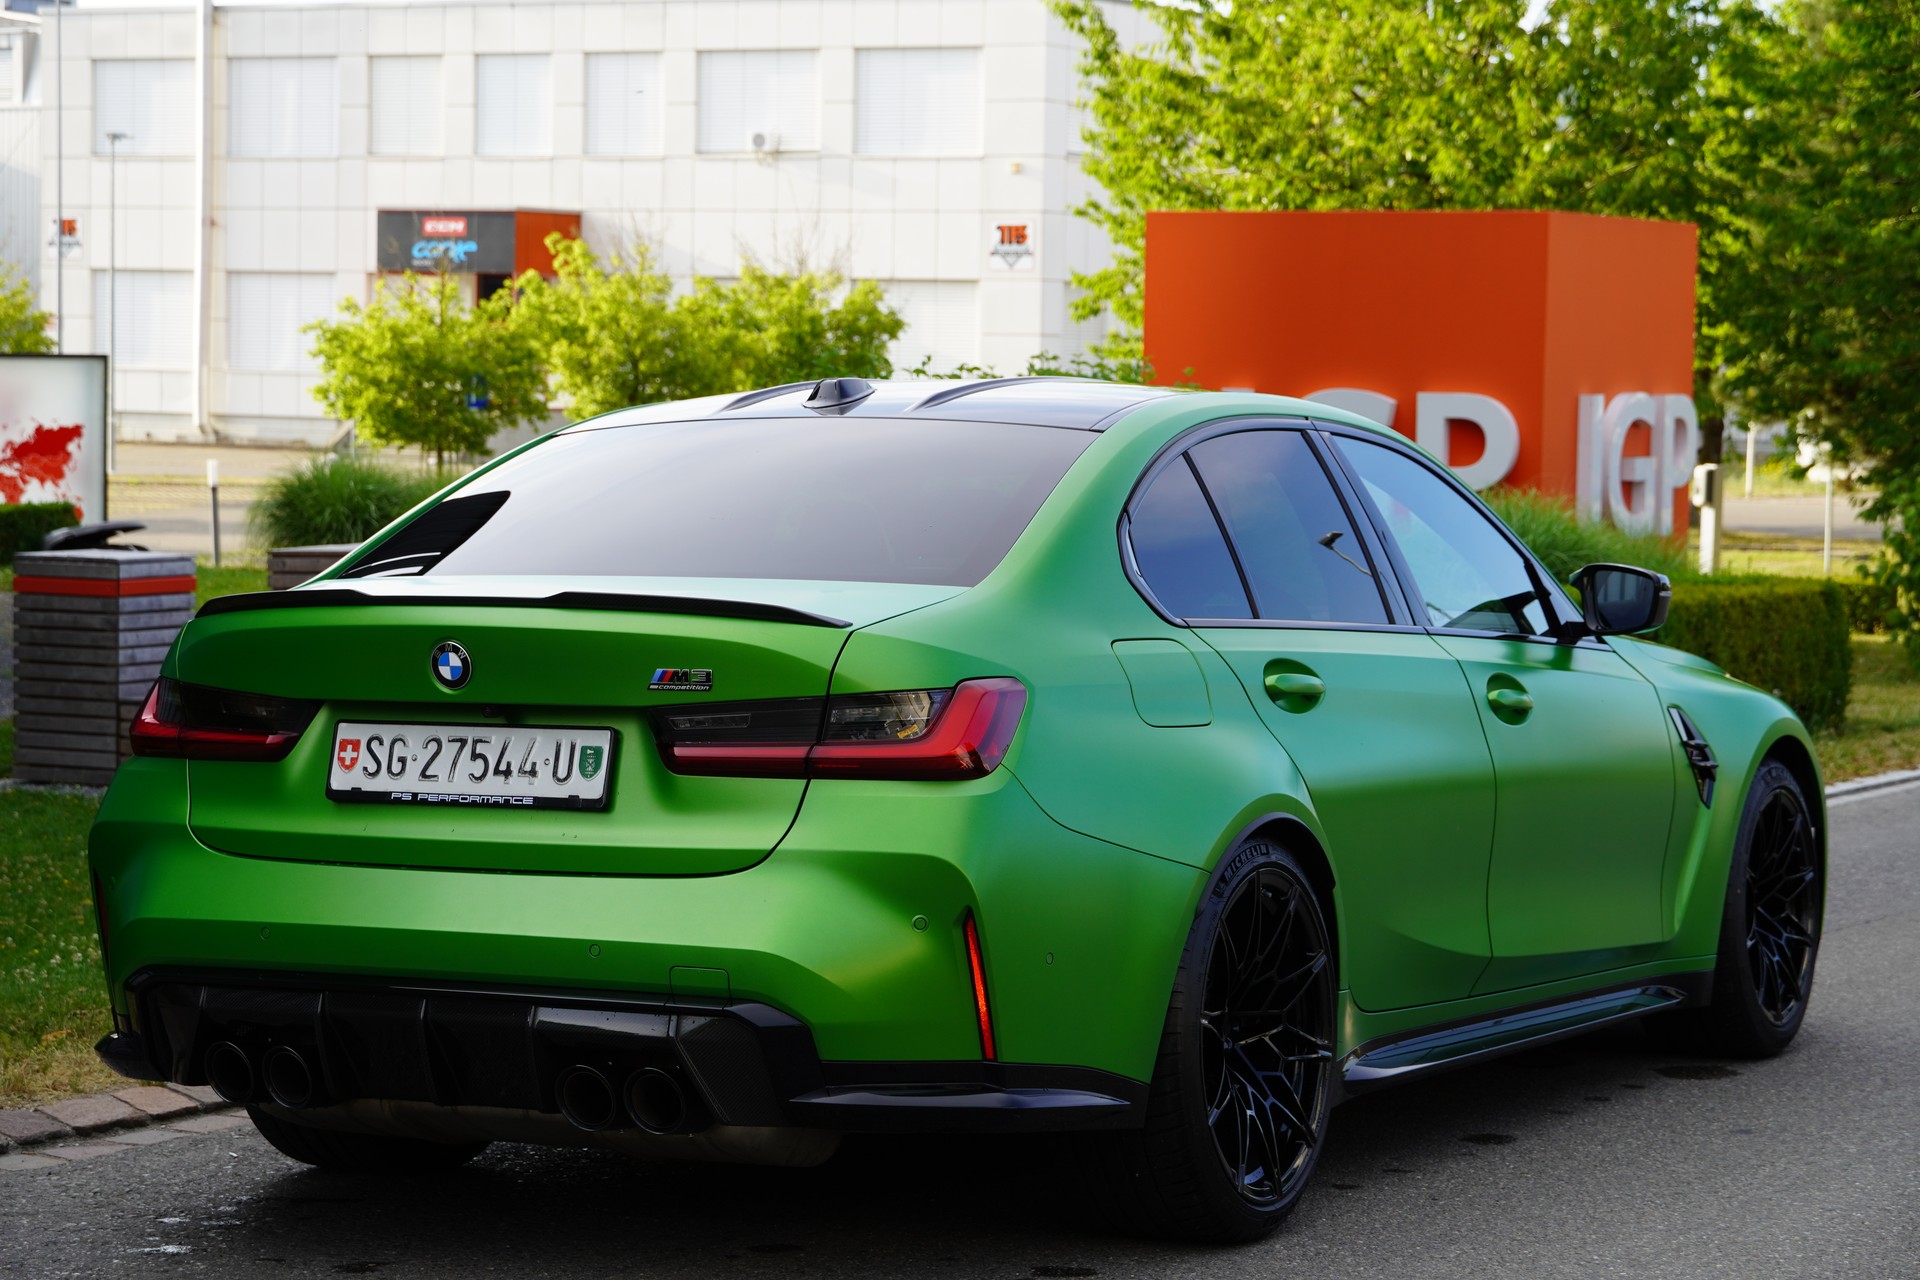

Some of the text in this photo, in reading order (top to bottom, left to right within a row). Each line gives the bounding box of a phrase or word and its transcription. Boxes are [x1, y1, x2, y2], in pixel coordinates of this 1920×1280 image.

[1577, 391, 1698, 538] IGP
[433, 643, 467, 660] BMW
[656, 668, 713, 684] M3
[391, 792, 534, 805] PS PERFORMANCE
[1224, 844, 1268, 881] MICHELIN
